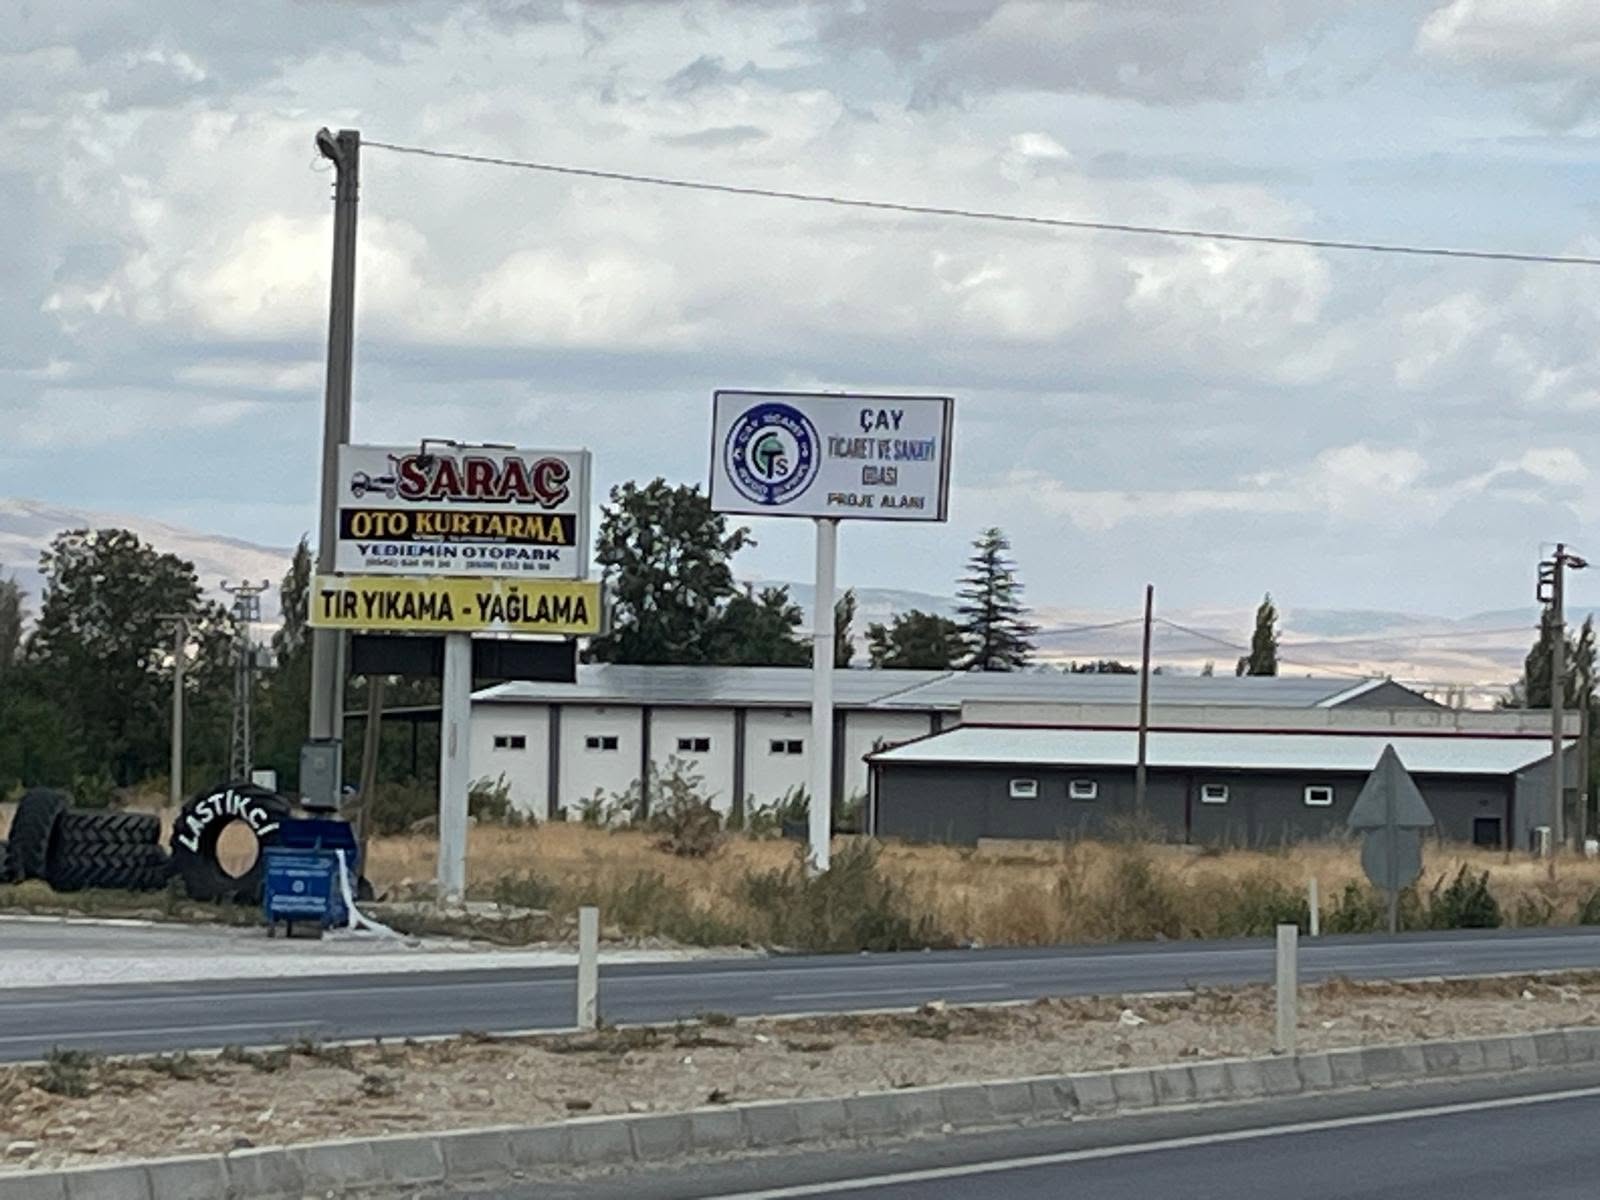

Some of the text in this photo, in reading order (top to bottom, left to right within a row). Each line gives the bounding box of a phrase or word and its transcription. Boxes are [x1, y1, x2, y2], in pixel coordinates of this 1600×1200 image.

[859, 408, 903, 433] ÇAY
[398, 453, 570, 509] SARAÇ
[826, 492, 926, 510] PROJE ALANI
[351, 511, 567, 544] OTO KURTARMA
[462, 547, 561, 562] OTOPARK
[321, 590, 357, 618] TIR
[361, 590, 454, 621] YIKAMA
[475, 587, 589, 625] YAĞLAMA
